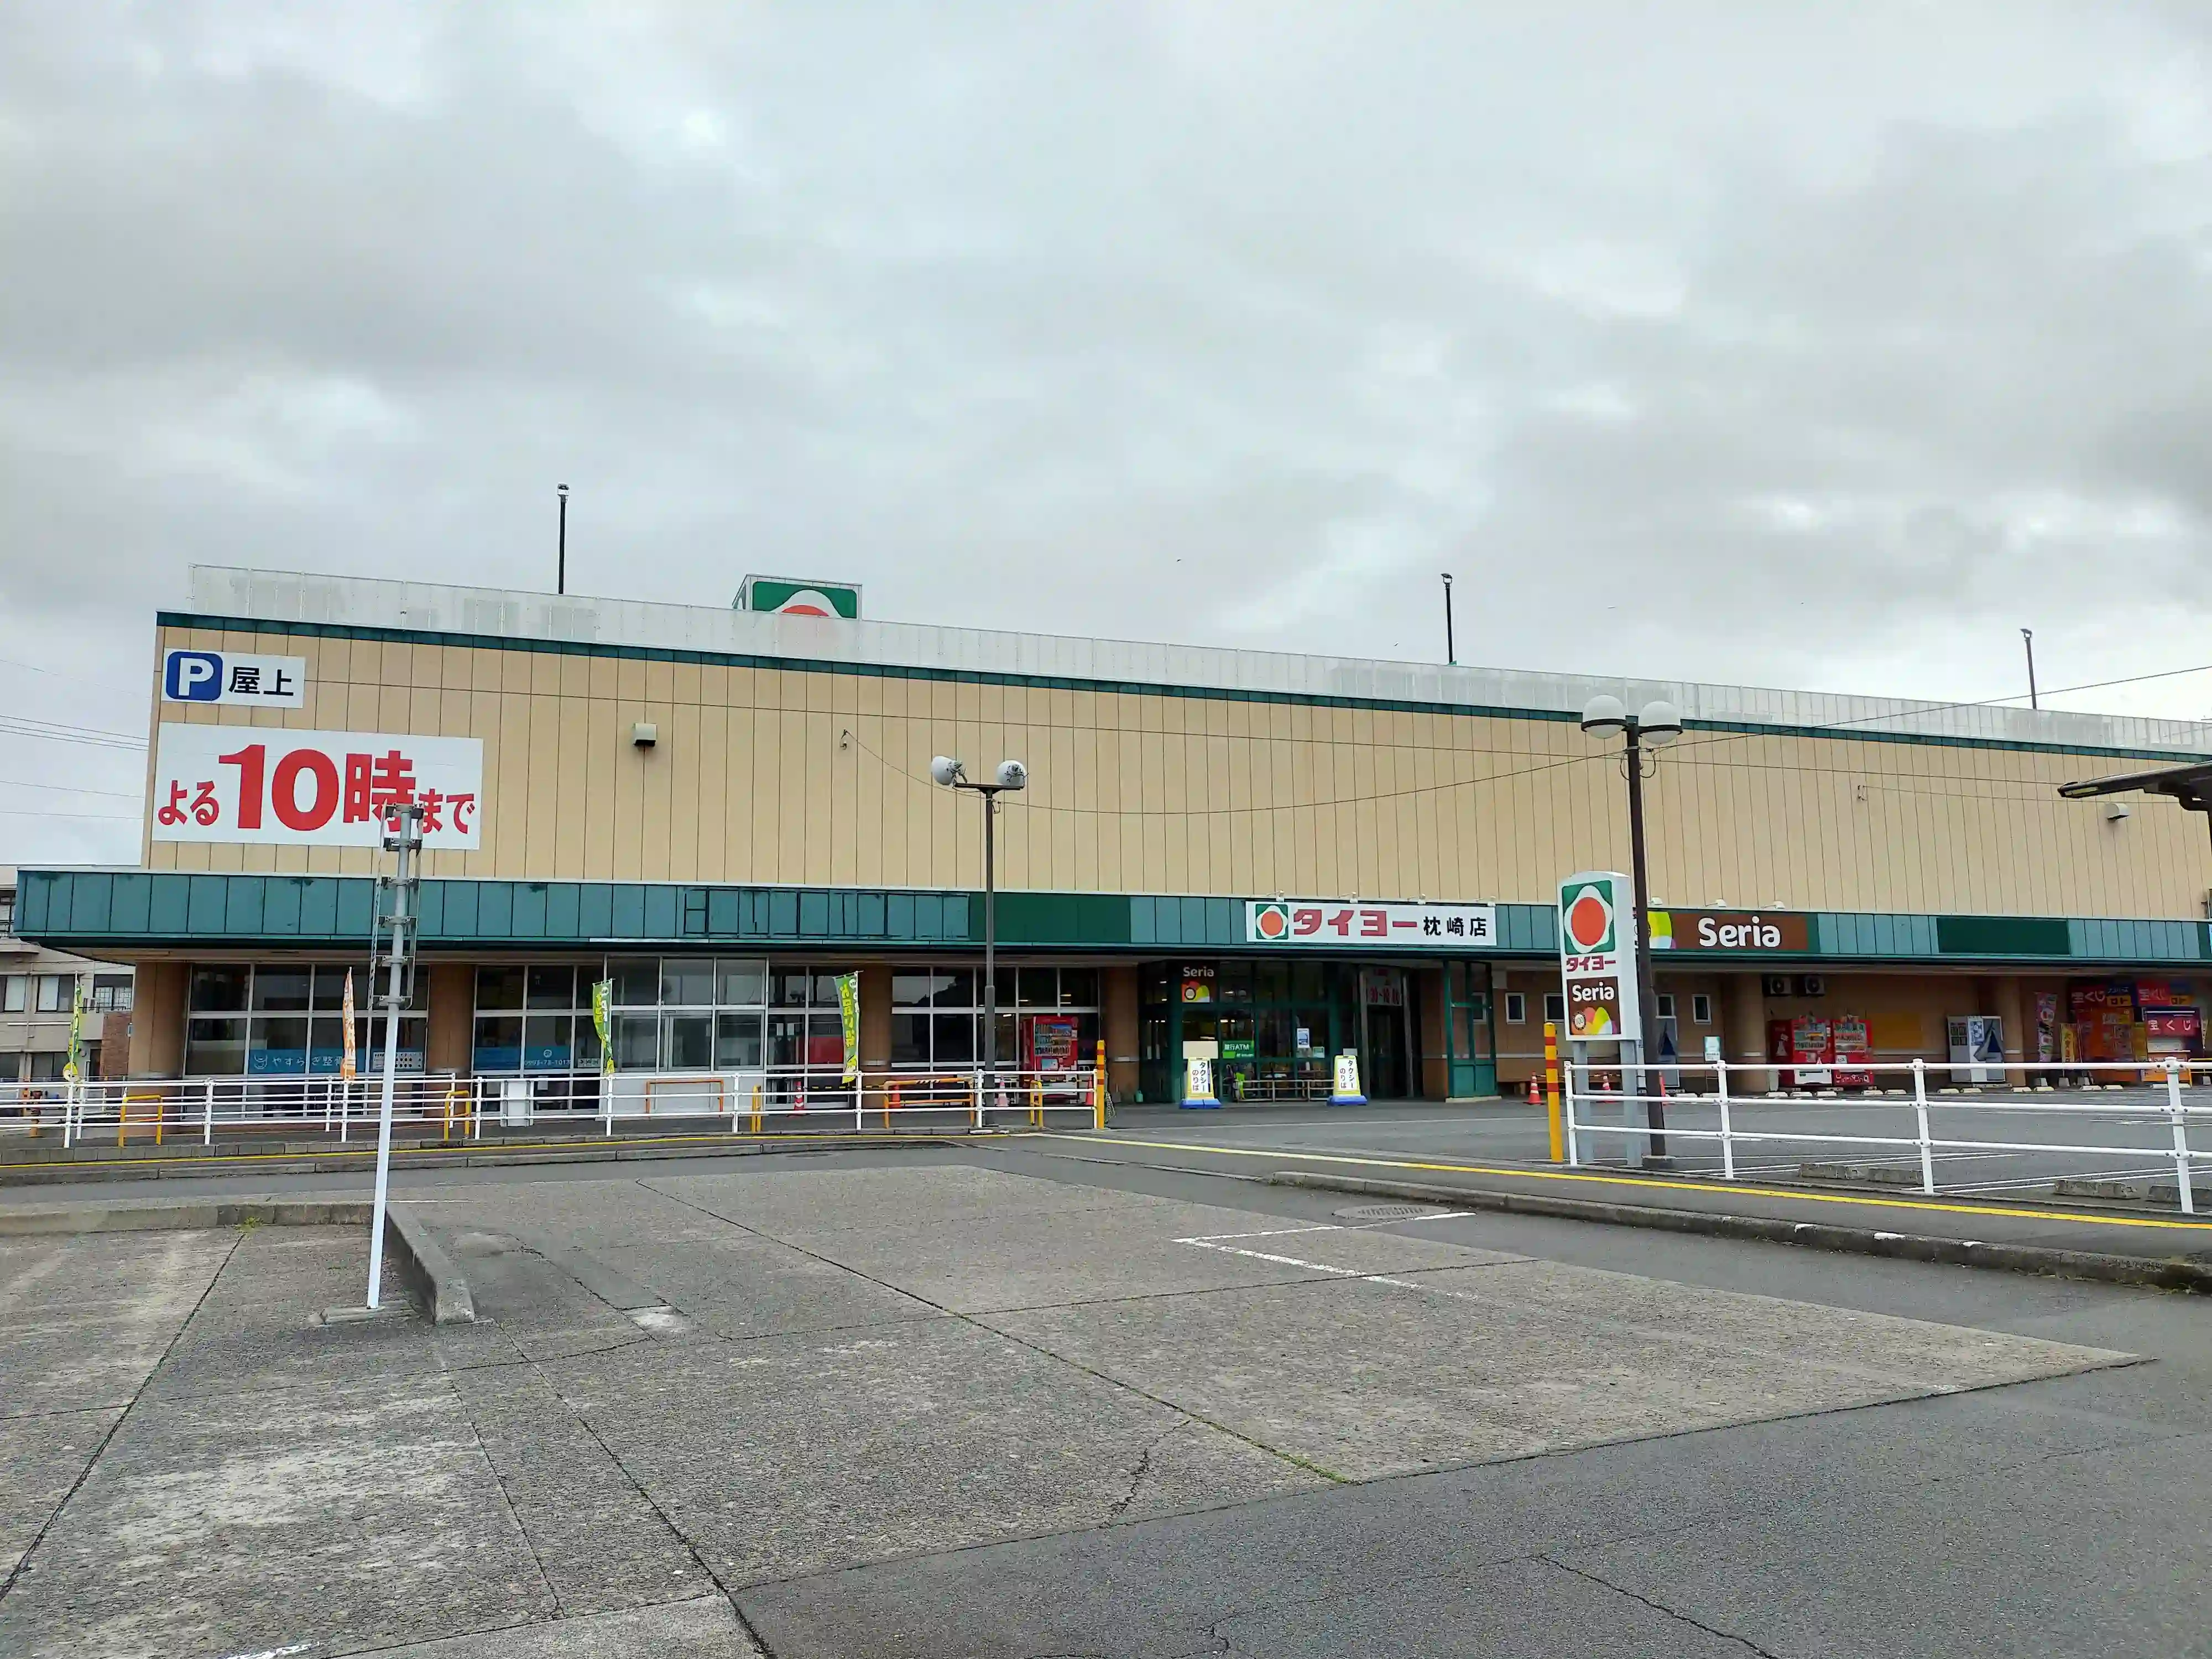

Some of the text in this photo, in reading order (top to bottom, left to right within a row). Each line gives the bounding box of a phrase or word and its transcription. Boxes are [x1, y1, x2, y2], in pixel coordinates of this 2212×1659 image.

[228, 666, 294, 697] 屋上
[1698, 916, 1781, 947] Seria
[1183, 966, 1214, 977] Seria
[1566, 955, 1616, 972] タイヨー
[1572, 981, 1615, 1002] Seria
